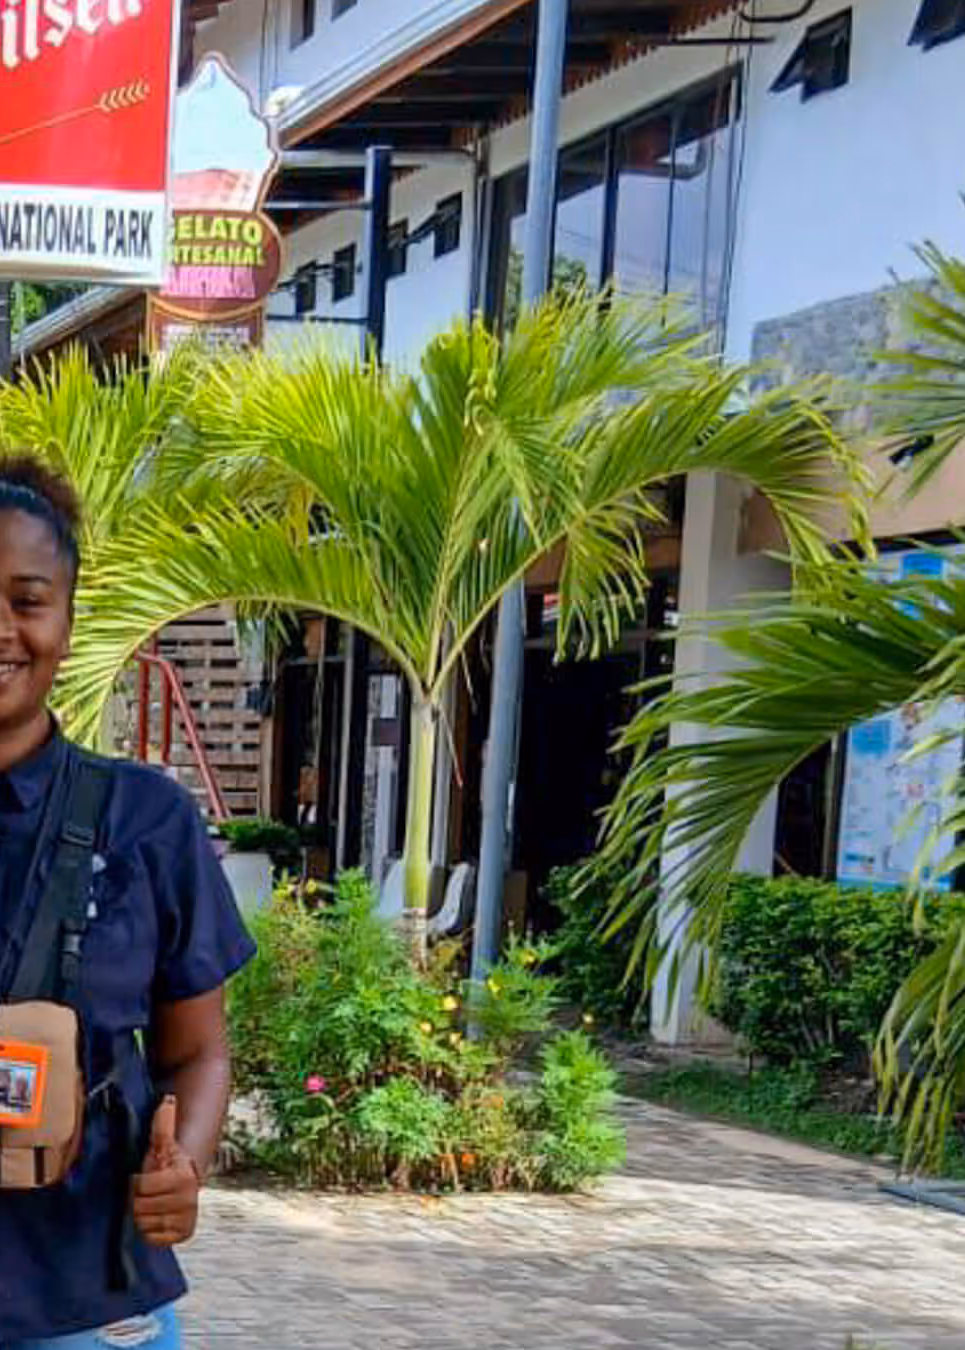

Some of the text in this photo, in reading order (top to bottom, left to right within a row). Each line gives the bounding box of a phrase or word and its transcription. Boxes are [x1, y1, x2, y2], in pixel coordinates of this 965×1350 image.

[103, 208, 153, 258] PARK
[174, 214, 263, 245] ELATO
[174, 244, 264, 265] TESANAL
